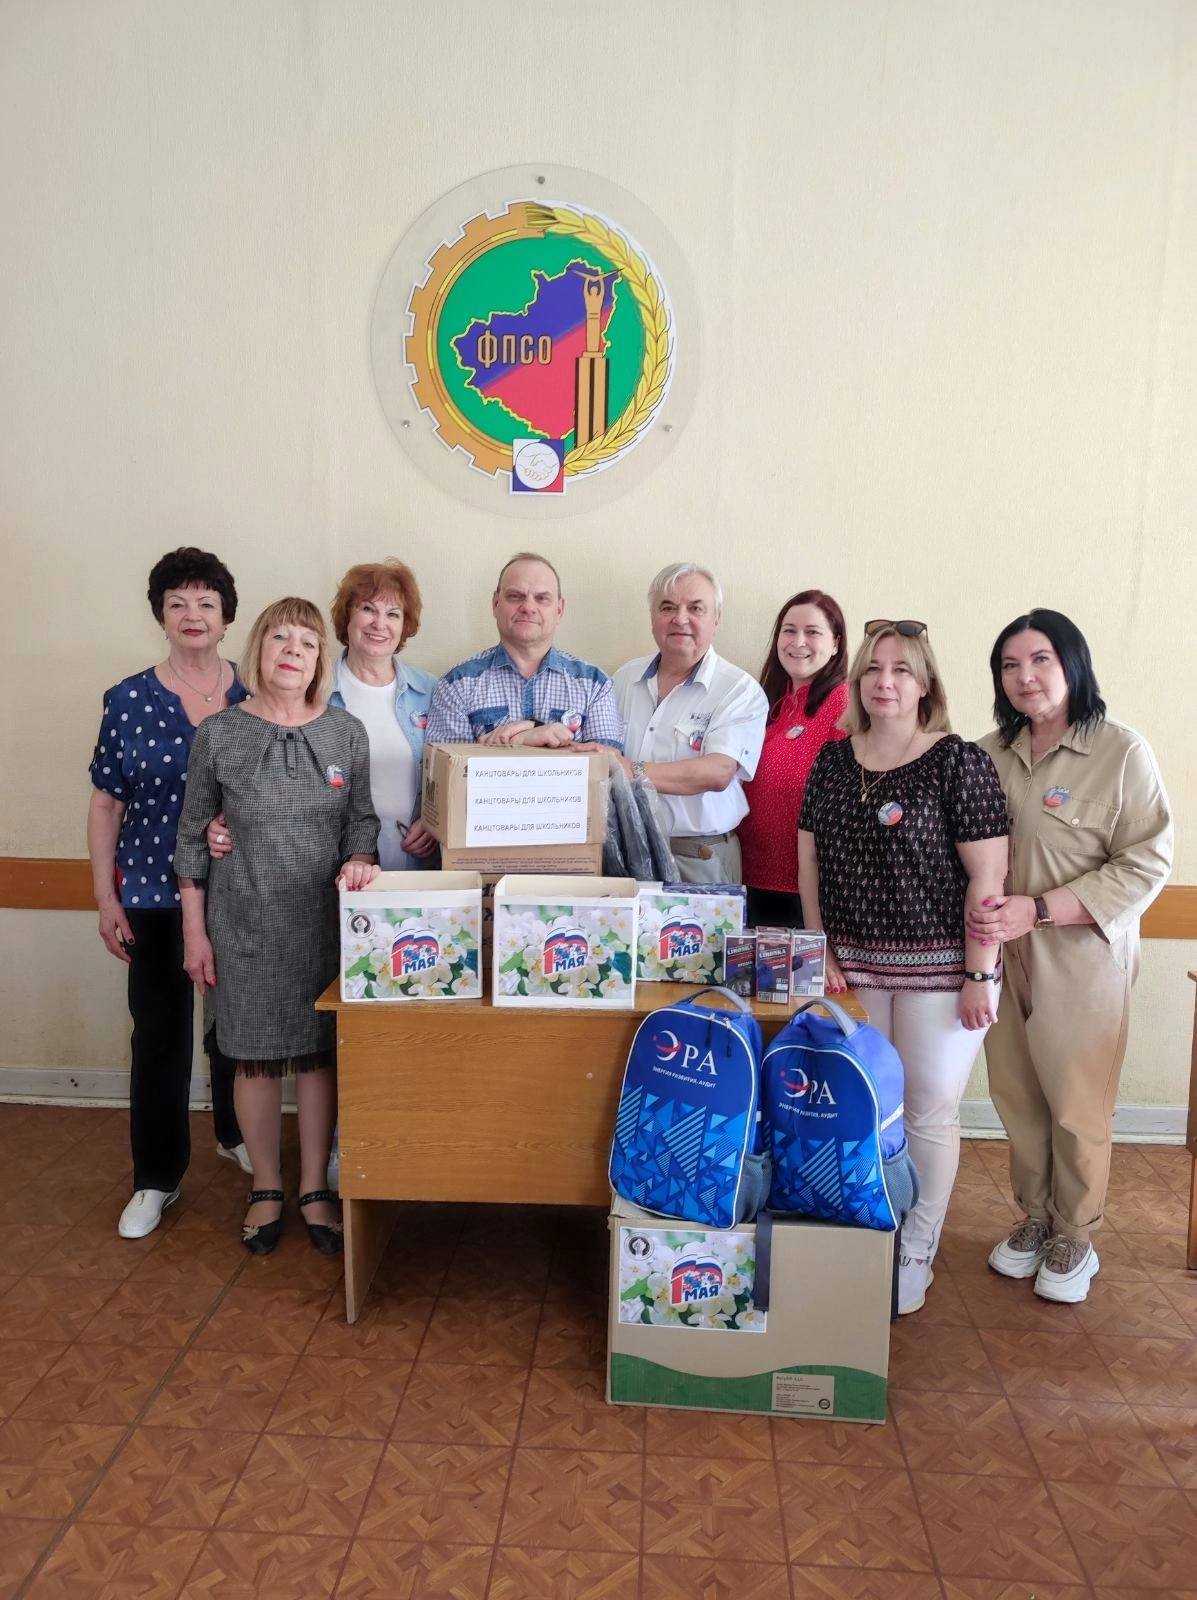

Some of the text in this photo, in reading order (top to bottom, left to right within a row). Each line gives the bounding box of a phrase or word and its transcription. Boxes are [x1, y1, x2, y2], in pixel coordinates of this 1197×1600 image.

[477, 329, 552, 369] ФПСО
[475, 770, 521, 778] КАНЦТОВАРЫ
[522, 770, 536, 778] ДЛЯ
[537, 769, 583, 777] ШКОЛЬНИКОВ
[474, 796, 582, 805] КАНЦТОВАРЫ ДЛЯ ШКОЛЬНИКОВ
[473, 822, 581, 832] КАНЦТОВАРЫ ДЛЯ ШКОЛЬНИКОВ
[671, 943, 701, 959] МАЯ
[404, 955, 437, 974] МАЯ
[555, 956, 585, 972] МАЯ
[683, 1284, 720, 1303] МАЯ
